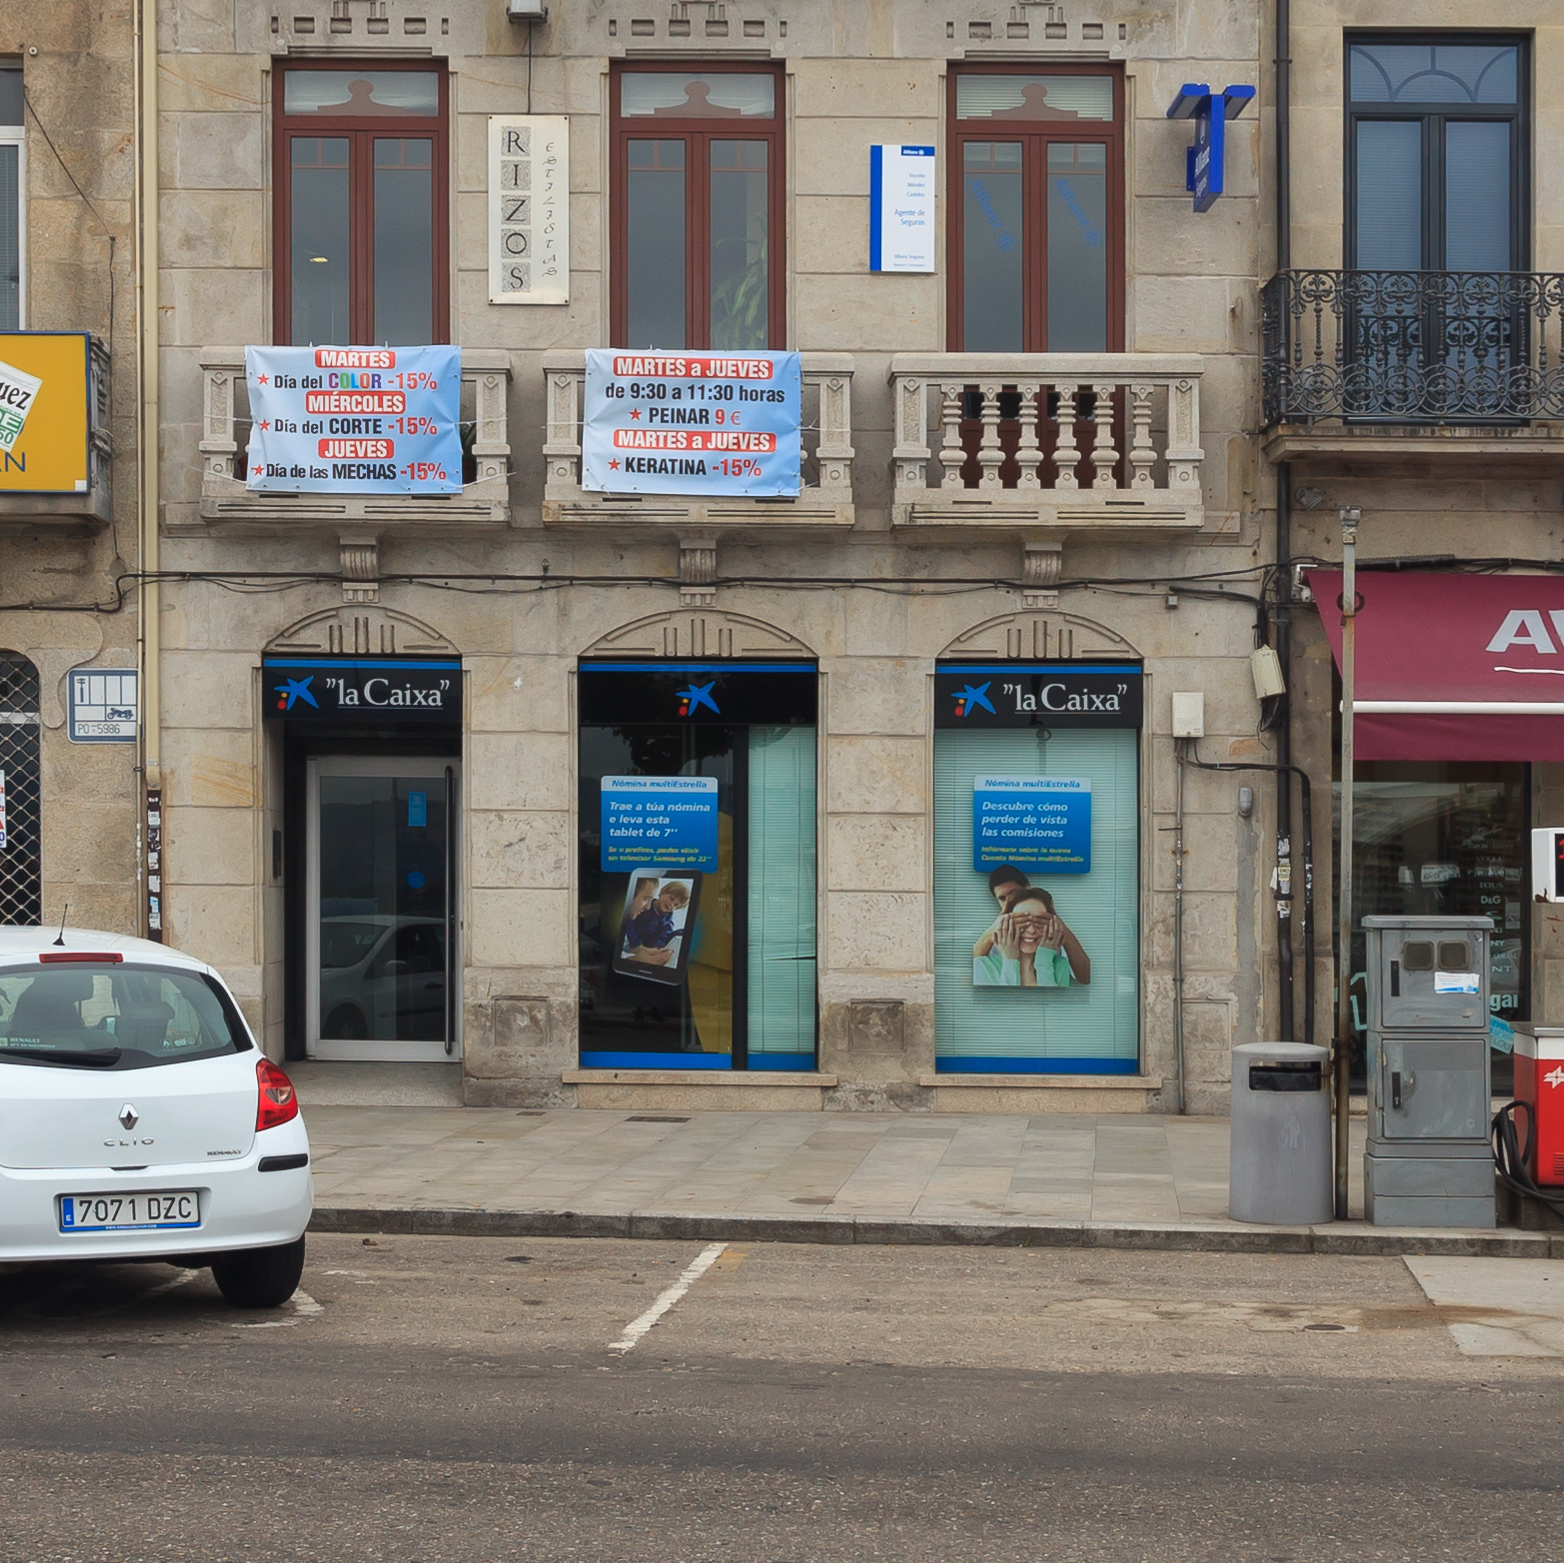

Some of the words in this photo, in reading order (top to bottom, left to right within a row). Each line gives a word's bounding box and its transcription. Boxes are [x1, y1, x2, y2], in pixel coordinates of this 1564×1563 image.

[506, 131, 527, 289] RIZOS
[321, 351, 390, 367] MARTES
[617, 358, 685, 376] MARTES
[706, 361, 769, 378] JUEVES
[301, 374, 323, 389] del
[329, 373, 382, 389] COLOR
[630, 384, 666, 400] 9:30
[687, 385, 733, 401] 11:30
[739, 386, 785, 403] horas
[308, 392, 404, 413] MIÉRCOLES
[649, 408, 709, 424] PEINAR
[275, 419, 298, 434] Día
[302, 420, 323, 434] del
[329, 419, 382, 435] CORTE
[324, 441, 387, 458] JUEVES
[618, 432, 687, 448] MARTES
[707, 433, 770, 451] JUEVES
[266, 463, 288, 477] Día
[310, 465, 328, 479] las
[332, 464, 396, 479] MECHAS
[625, 458, 706, 475] KERATINA
[1023, 780, 1080, 788] multiEstrella
[610, 802, 632, 810] Trae
[668, 803, 710, 811] nómina
[982, 802, 1034, 811] Descubre
[1038, 803, 1068, 811] cómo
[619, 815, 642, 823] leva
[646, 816, 669, 824] esta
[982, 816, 1020, 825] perder
[1041, 815, 1067, 824] vista
[610, 828, 643, 836] tablet
[982, 827, 998, 836] las
[1001, 828, 1063, 837] comisiones
[1481, 895, 1501, 904] D&G
[104, 1137, 154, 1147] CLIO
[79, 1199, 136, 1222] 7071
[148, 1196, 191, 1220] DZC
